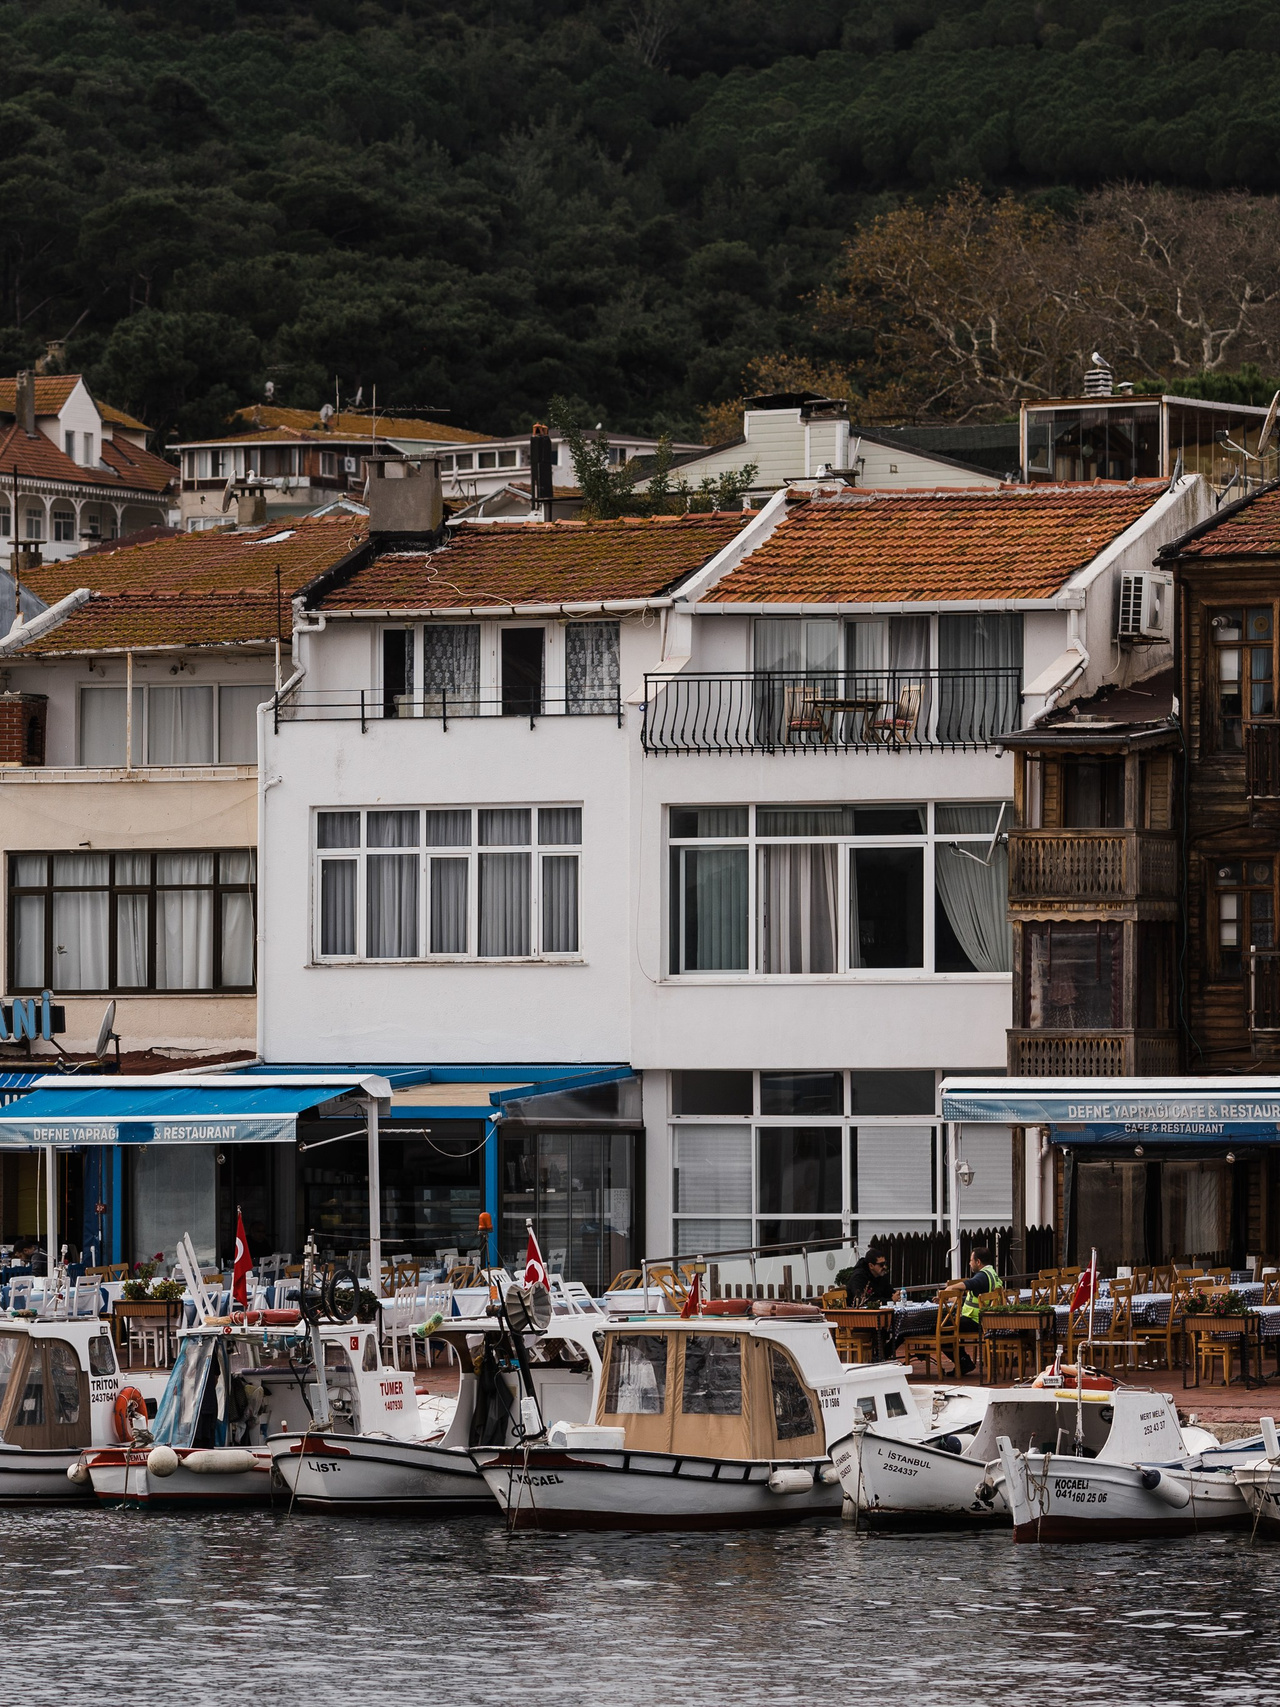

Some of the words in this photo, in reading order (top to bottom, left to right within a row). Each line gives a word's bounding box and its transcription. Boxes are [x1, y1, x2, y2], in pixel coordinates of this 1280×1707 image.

[1068, 1105, 1111, 1118] DEFNE
[1113, 1102, 1169, 1118] YAPRAĞI
[1172, 1105, 1205, 1118] CAFE
[1208, 1105, 1218, 1118] &
[33, 1128, 69, 1141] DEFNE
[72, 1125, 119, 1140] YAPRAĞI
[153, 1127, 161, 1140] &
[164, 1126, 237, 1140] RESTAURANT
[1124, 1123, 1150, 1133] CAFE
[1151, 1124, 1158, 1132] &
[1160, 1123, 1224, 1133] RESTAURANT
[91, 1377, 119, 1391] TRİTON
[91, 1392, 117, 1403] 2437641
[878, 1448, 883, 1456] L
[887, 1450, 931, 1469] İSTANBUL
[883, 1463, 918, 1477] 2524337
[1054, 1479, 1089, 1490] KOCAELİ
[1055, 1489, 1072, 1498] 041
[1072, 1492, 1086, 1502] 160
[1086, 1493, 1097, 1503] 25
[1098, 1493, 1108, 1503] 06
